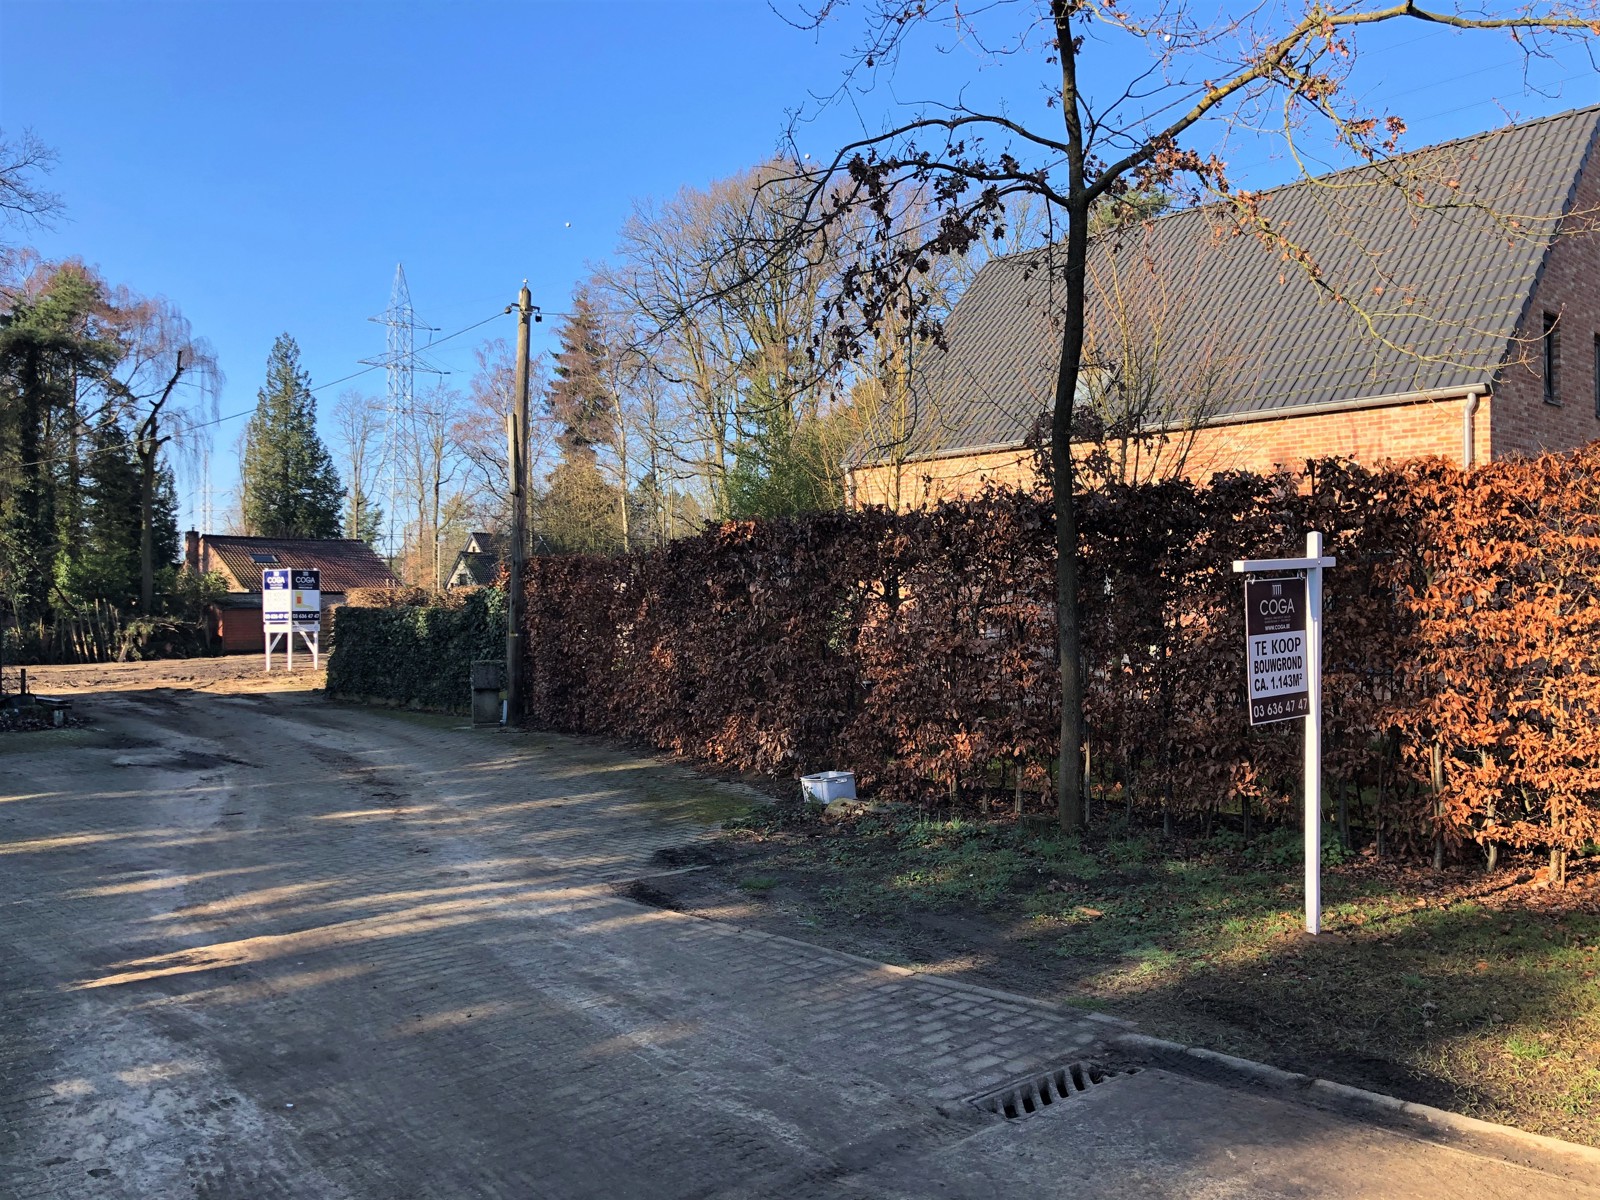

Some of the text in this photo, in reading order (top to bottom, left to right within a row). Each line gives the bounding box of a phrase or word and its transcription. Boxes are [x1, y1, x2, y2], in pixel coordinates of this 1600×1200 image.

[1260, 598, 1295, 616] COGA
[1254, 637, 1301, 656] TE KOOP
[1254, 656, 1302, 674] BOUWGROND
[1254, 678, 1268, 692] CA.
[1254, 698, 1308, 718] 03 636 47 47
